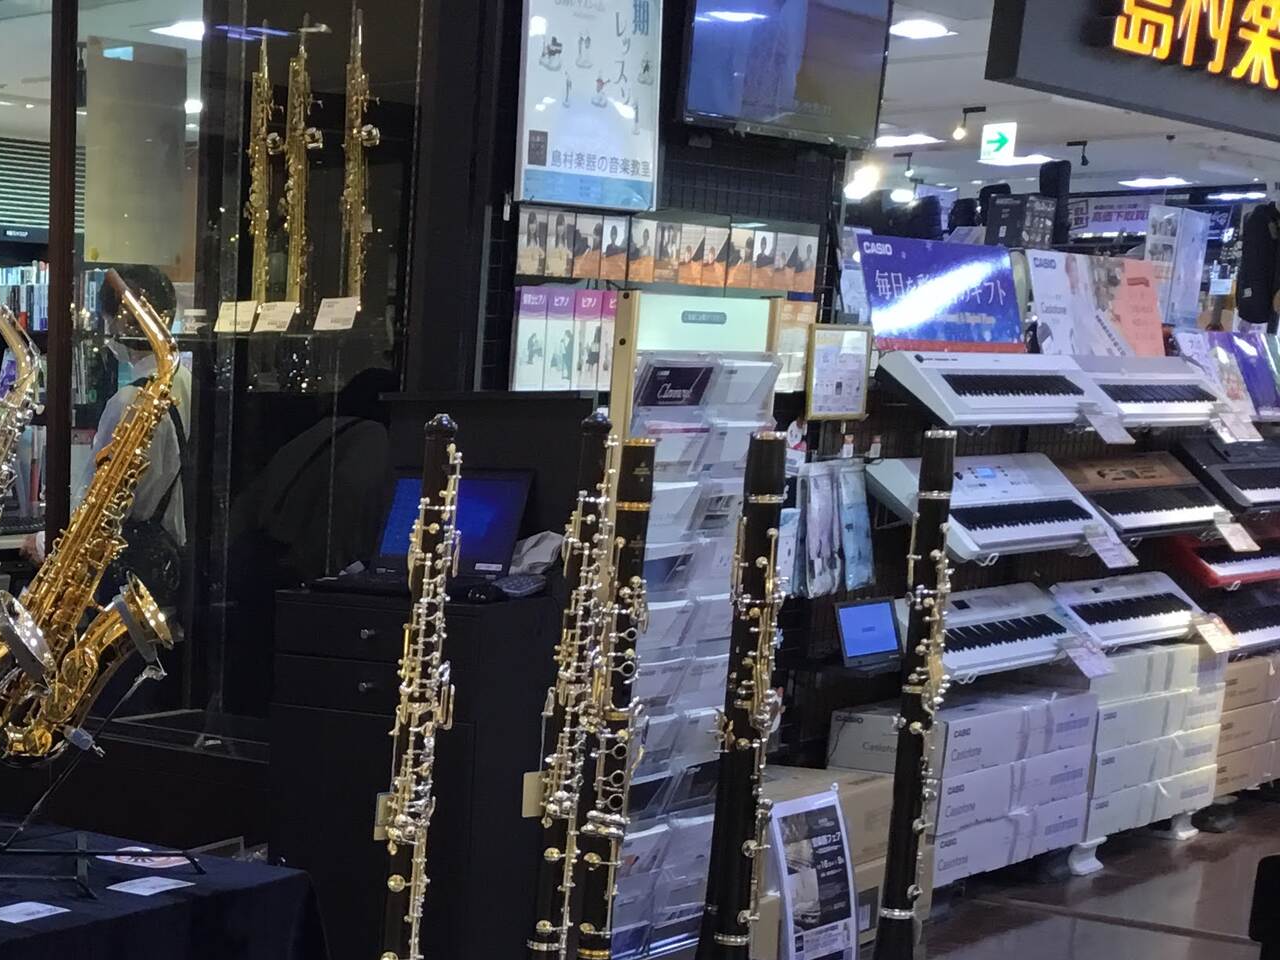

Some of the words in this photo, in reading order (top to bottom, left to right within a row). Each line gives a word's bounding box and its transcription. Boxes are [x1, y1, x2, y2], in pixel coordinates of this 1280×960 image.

[550, 150, 652, 178] 島村楽器の音楽教室
[863, 241, 892, 256] CASIO
[1033, 256, 1056, 269] CASIO
[835, 714, 864, 724] CASIO
[953, 727, 971, 739] CASIO
[947, 783, 965, 795] CASIO
